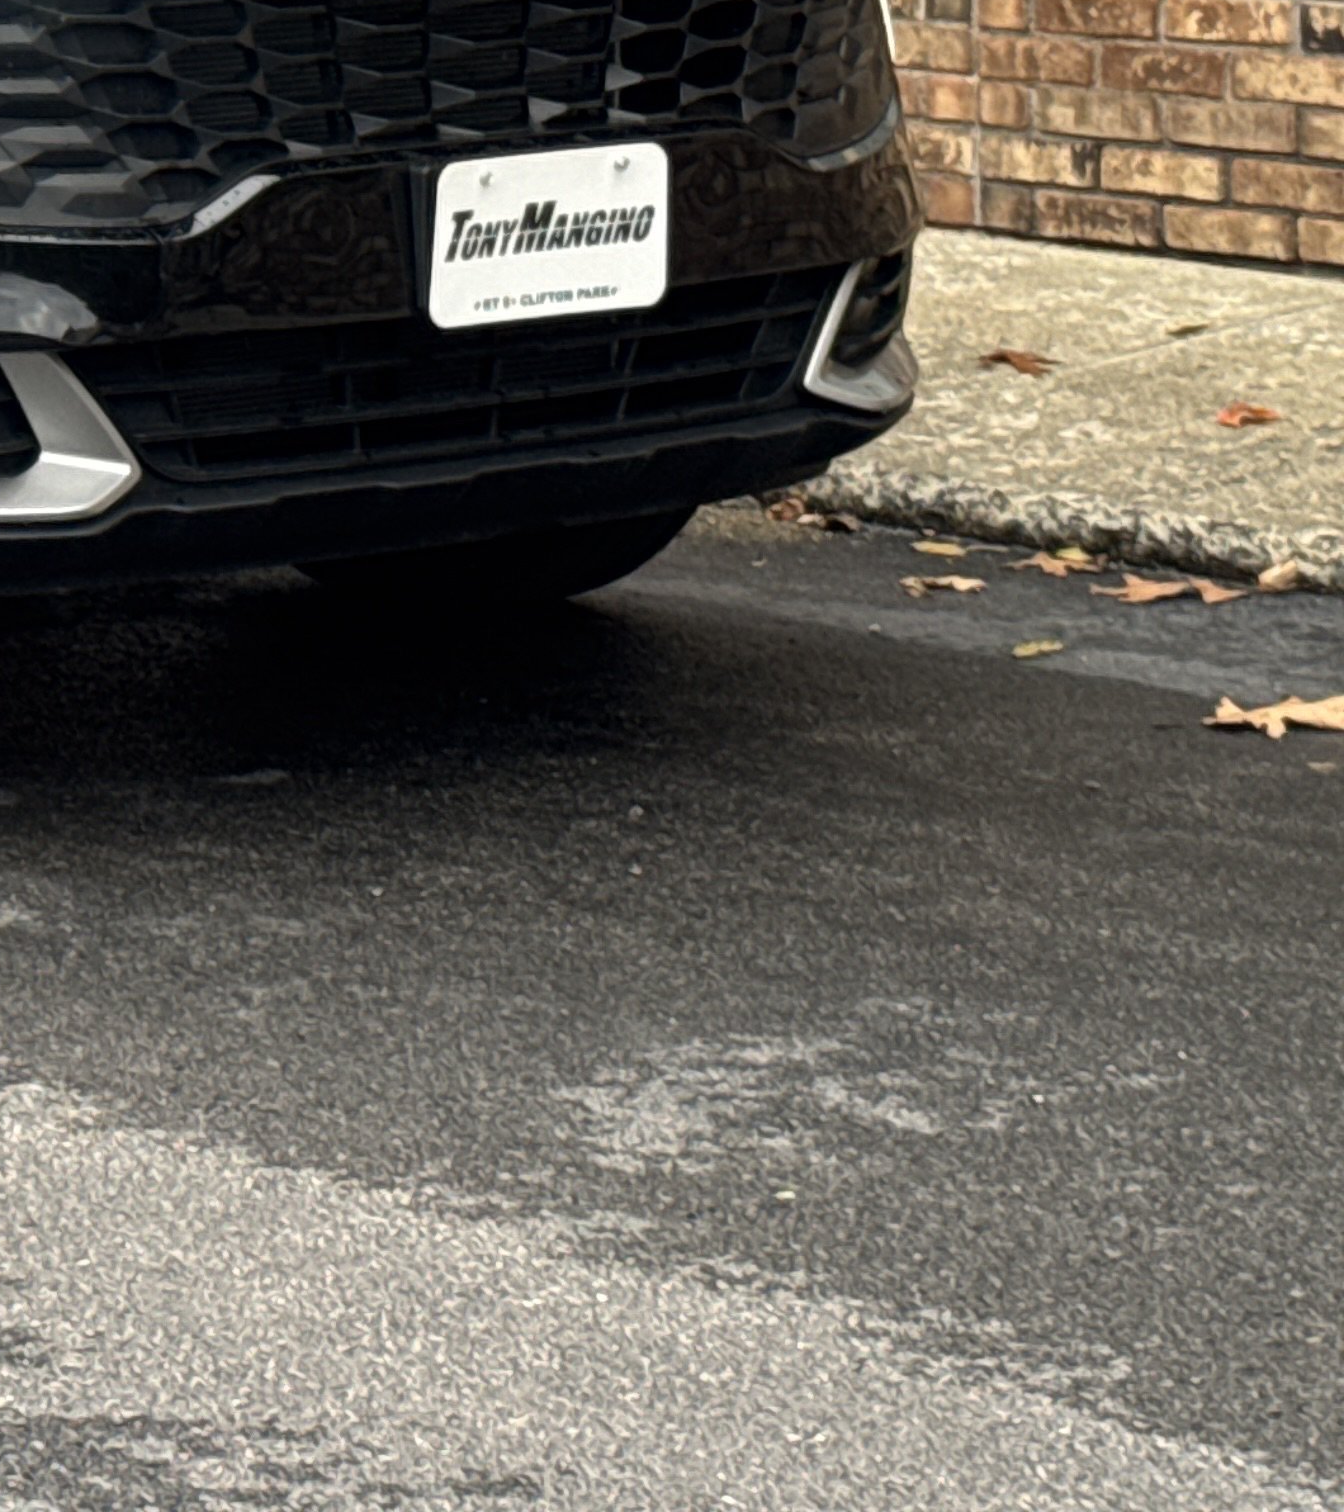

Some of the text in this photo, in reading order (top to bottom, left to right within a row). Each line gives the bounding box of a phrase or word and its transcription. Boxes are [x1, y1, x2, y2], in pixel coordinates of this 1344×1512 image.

[444, 200, 655, 262] TONY MANGINO
[519, 290, 574, 307] CLIFTON
